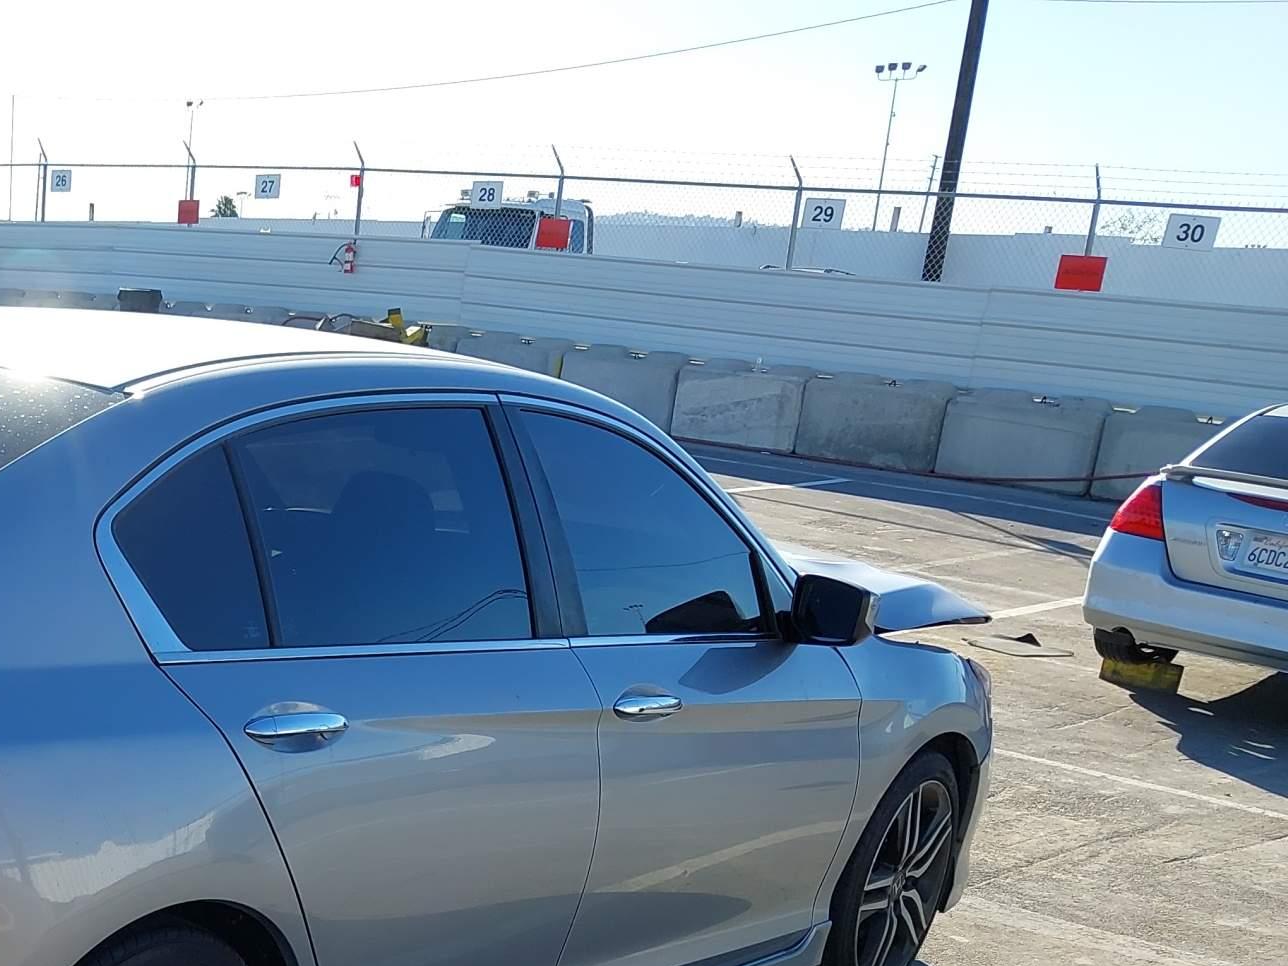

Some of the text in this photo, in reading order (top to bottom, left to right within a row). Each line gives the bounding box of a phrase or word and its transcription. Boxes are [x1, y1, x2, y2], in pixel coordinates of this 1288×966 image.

[55, 174, 67, 187] 26
[260, 180, 275, 194] 27
[478, 187, 495, 202] 28
[811, 205, 834, 223] 29
[1176, 222, 1205, 243] 30
